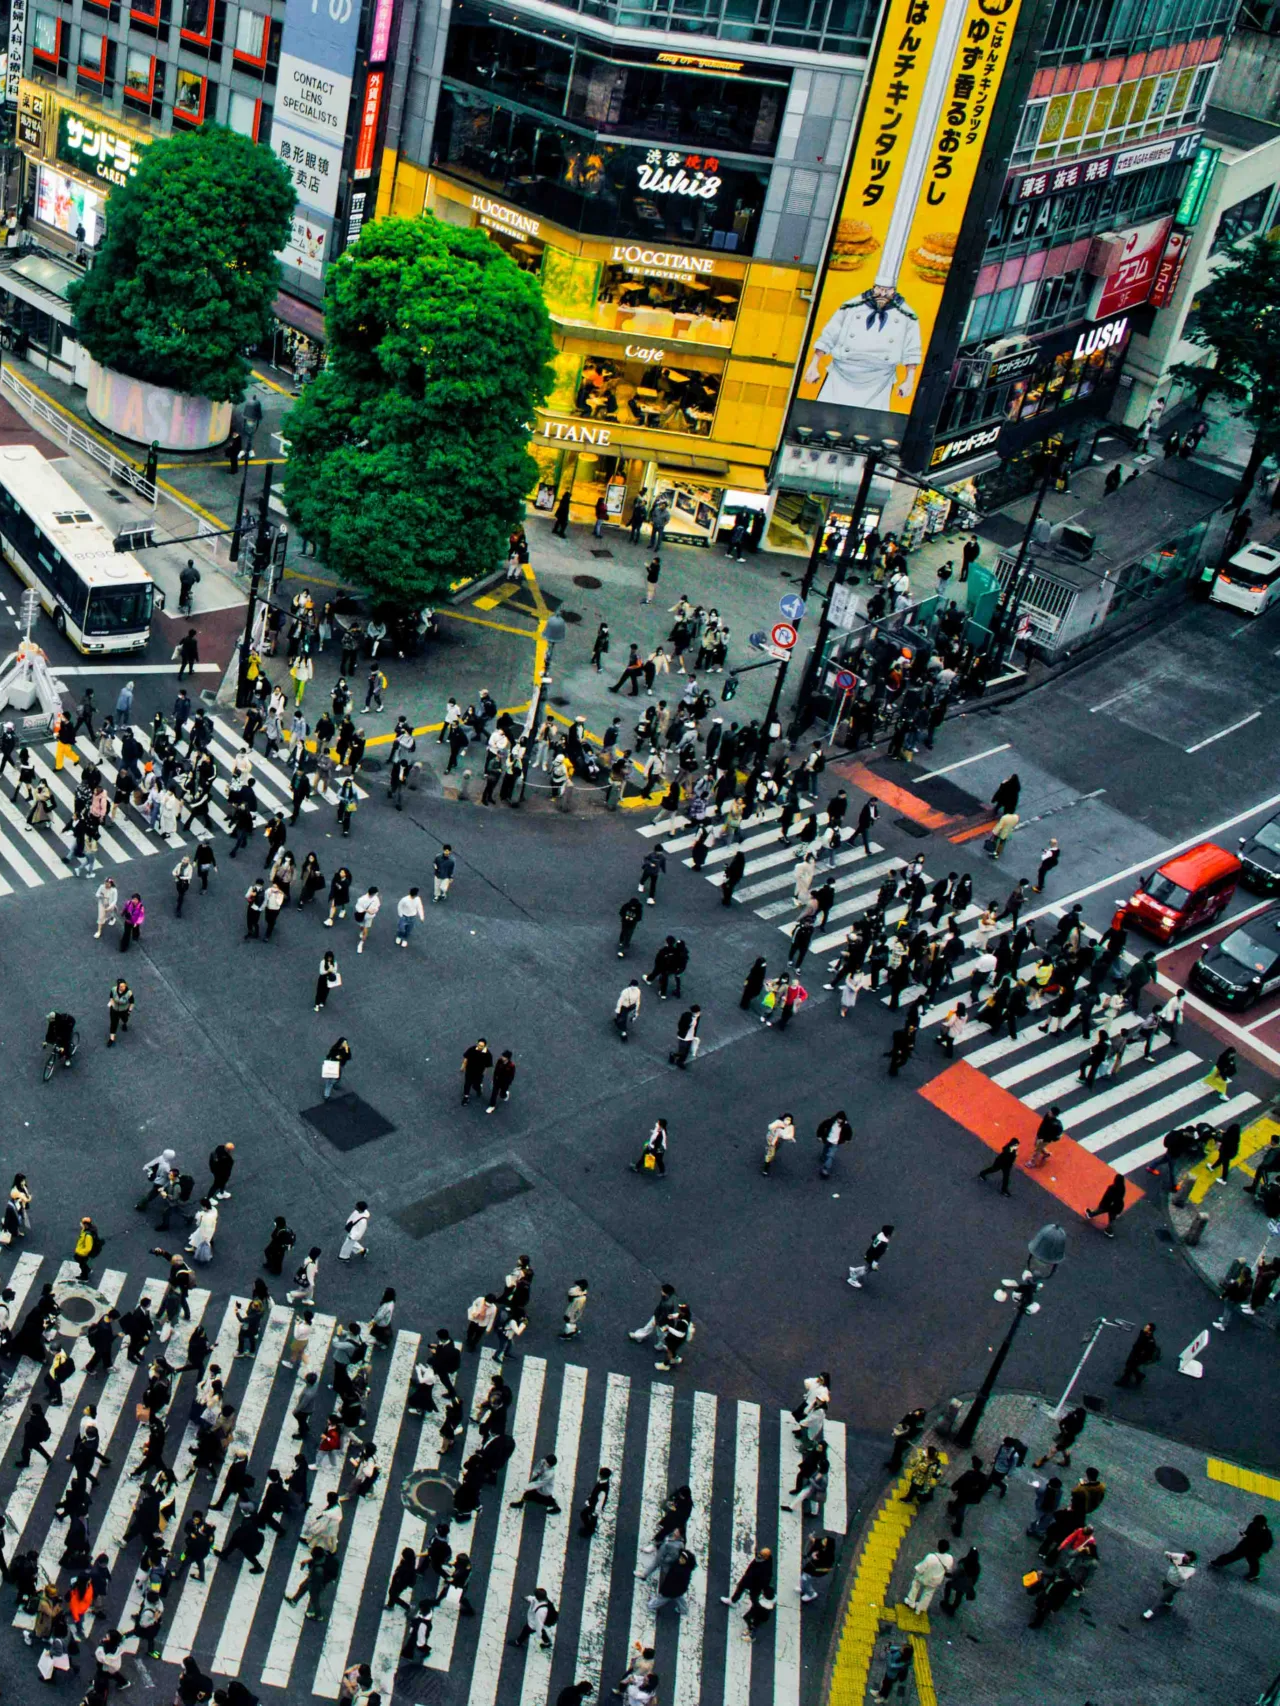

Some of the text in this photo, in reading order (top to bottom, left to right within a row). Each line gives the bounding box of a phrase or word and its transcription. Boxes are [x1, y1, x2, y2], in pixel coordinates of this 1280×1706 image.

[293, 70, 335, 95] CONTACT
[300, 88, 323, 106] LENS
[283, 95, 338, 128] SPECIALISTS
[926, 18, 990, 206] ゆず香るおろし
[646, 149, 680, 167] 渋谷
[1176, 133, 1201, 159] 4F
[636, 164, 722, 199] Ushi8
[471, 194, 540, 236] L'OCCITANE
[613, 246, 714, 273] L'OCCITANE
[625, 344, 665, 363] Café
[1073, 317, 1128, 361] LUSH
[951, 426, 1001, 457] サンドラッグ
